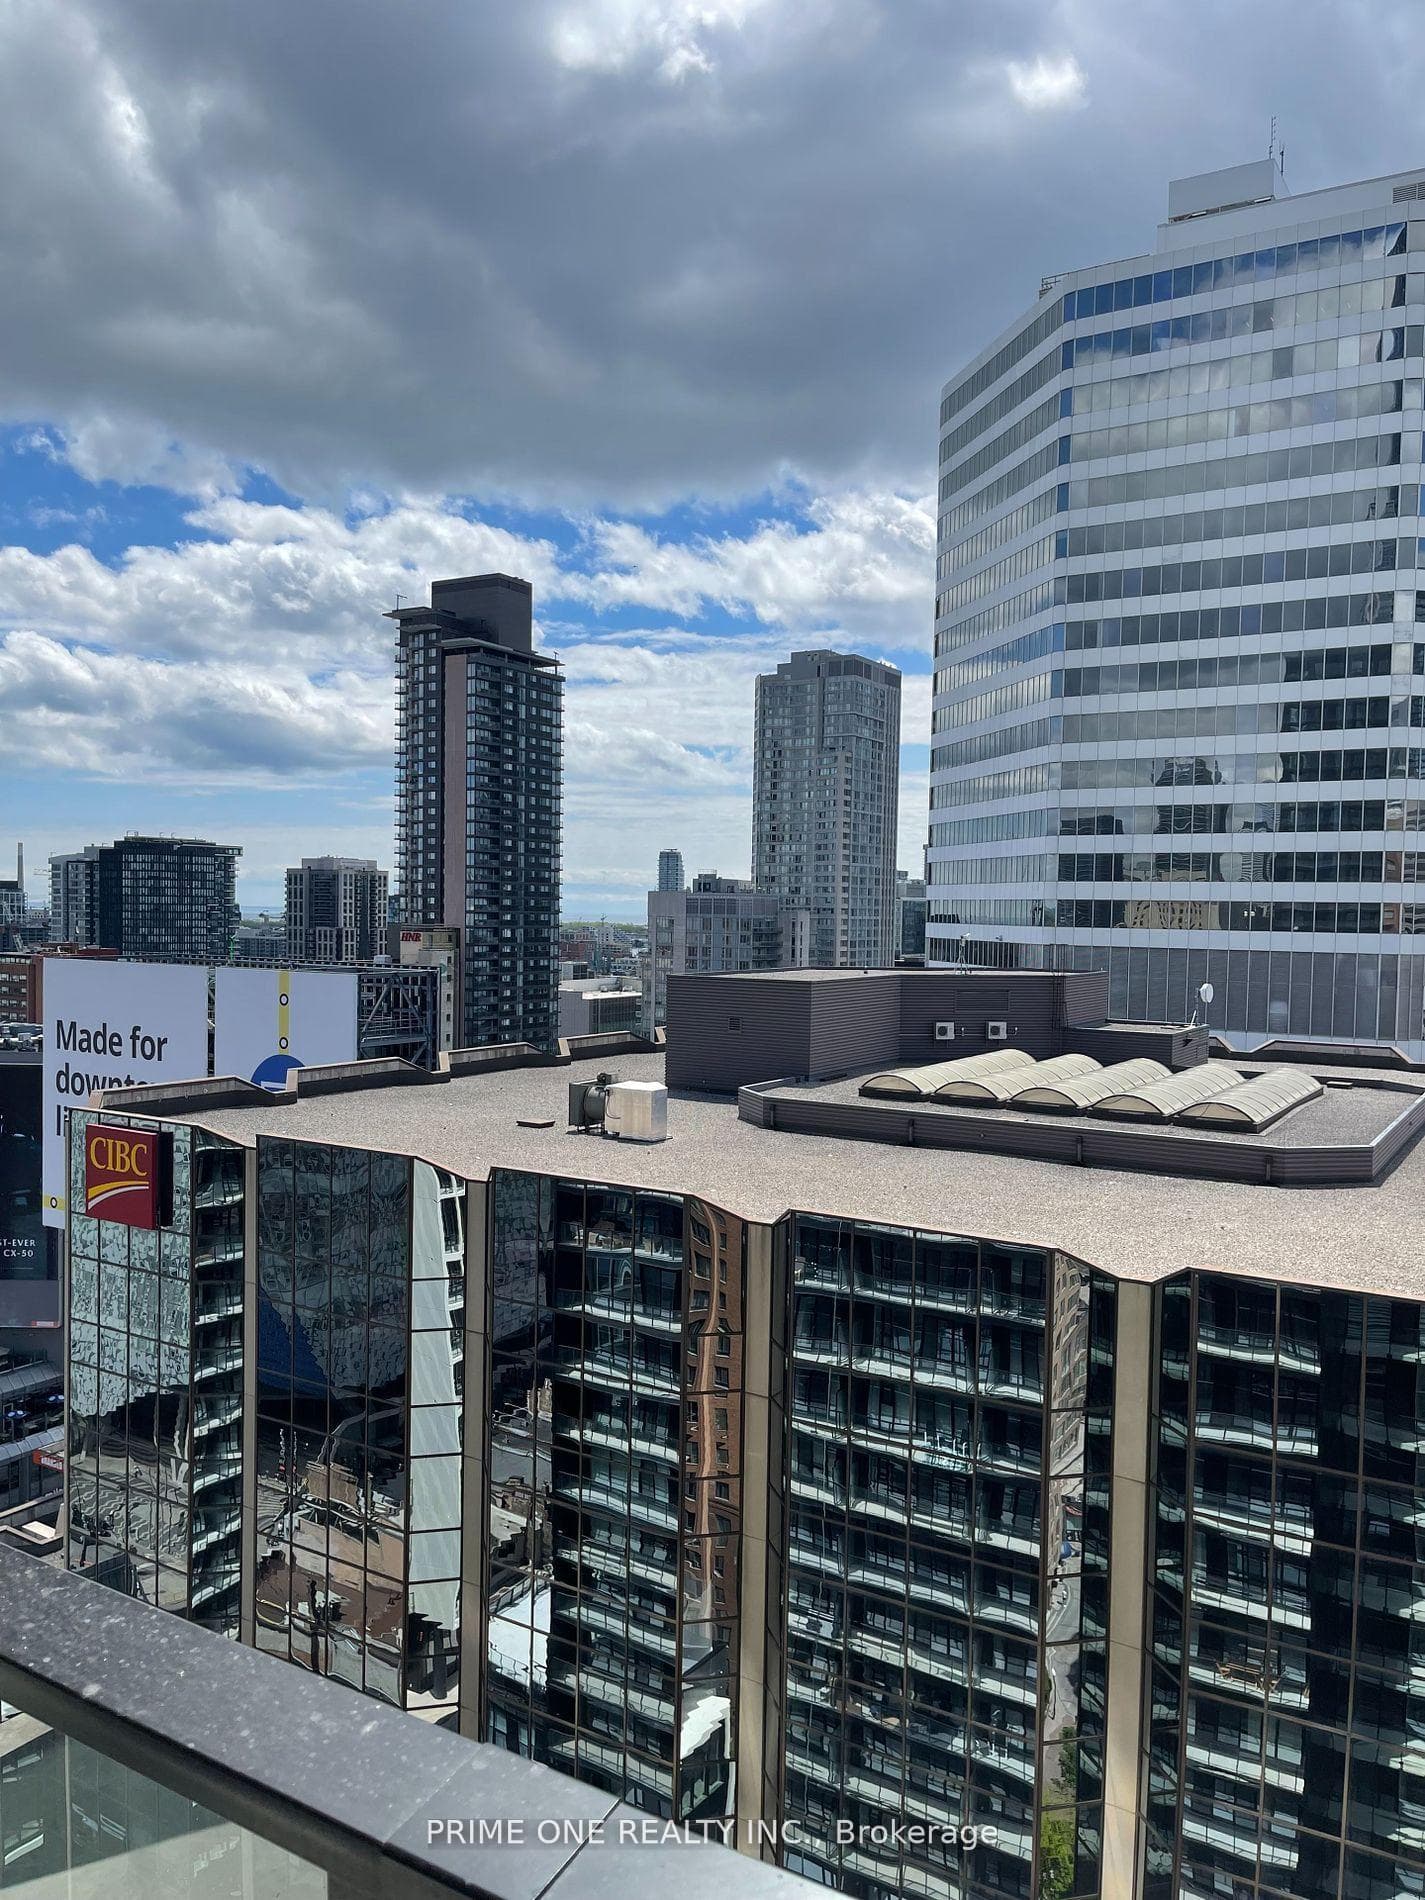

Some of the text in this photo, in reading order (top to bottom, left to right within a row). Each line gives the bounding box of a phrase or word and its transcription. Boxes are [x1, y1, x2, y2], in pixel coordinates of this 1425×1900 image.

[56, 1019, 168, 1061] Made for
[90, 1136, 148, 1177] CIBC
[3, 1249, 34, 1258] CX-50
